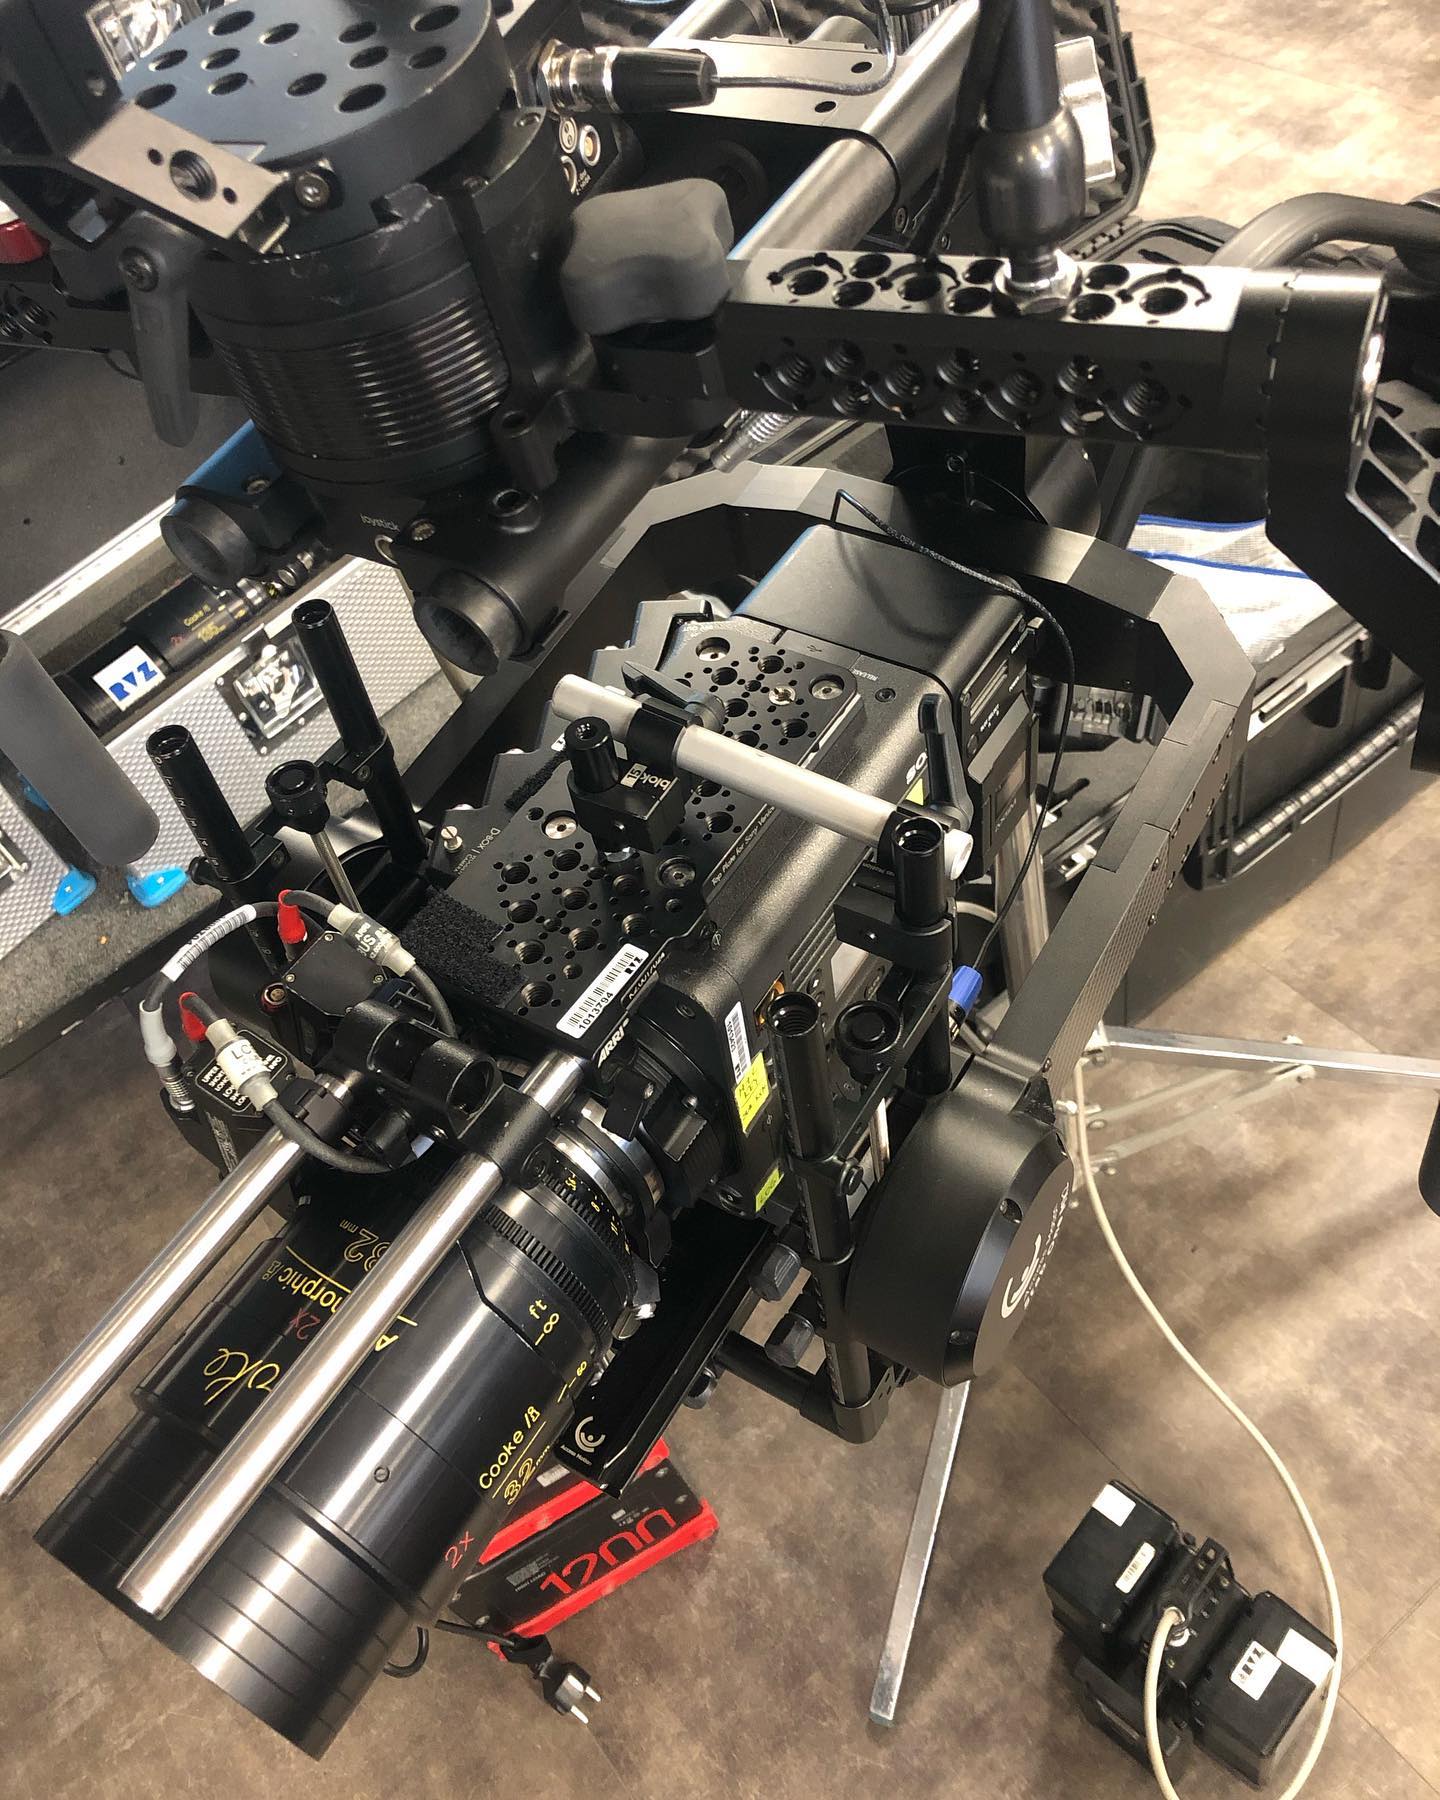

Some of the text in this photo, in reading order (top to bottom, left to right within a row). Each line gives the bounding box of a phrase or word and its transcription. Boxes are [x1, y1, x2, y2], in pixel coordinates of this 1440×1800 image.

[108, 660, 159, 702] RVZ
[851, 668, 879, 682] RELEASE
[711, 873, 723, 886] Top
[722, 855, 736, 873] Plate
[736, 843, 745, 855] for
[578, 992, 614, 1030] 1013794
[598, 1025, 625, 1069] ARRI
[529, 1299, 548, 1319] ft
[576, 1361, 588, 1377] 60
[479, 1430, 525, 1490] Cooke
[575, 1452, 593, 1467] Motion
